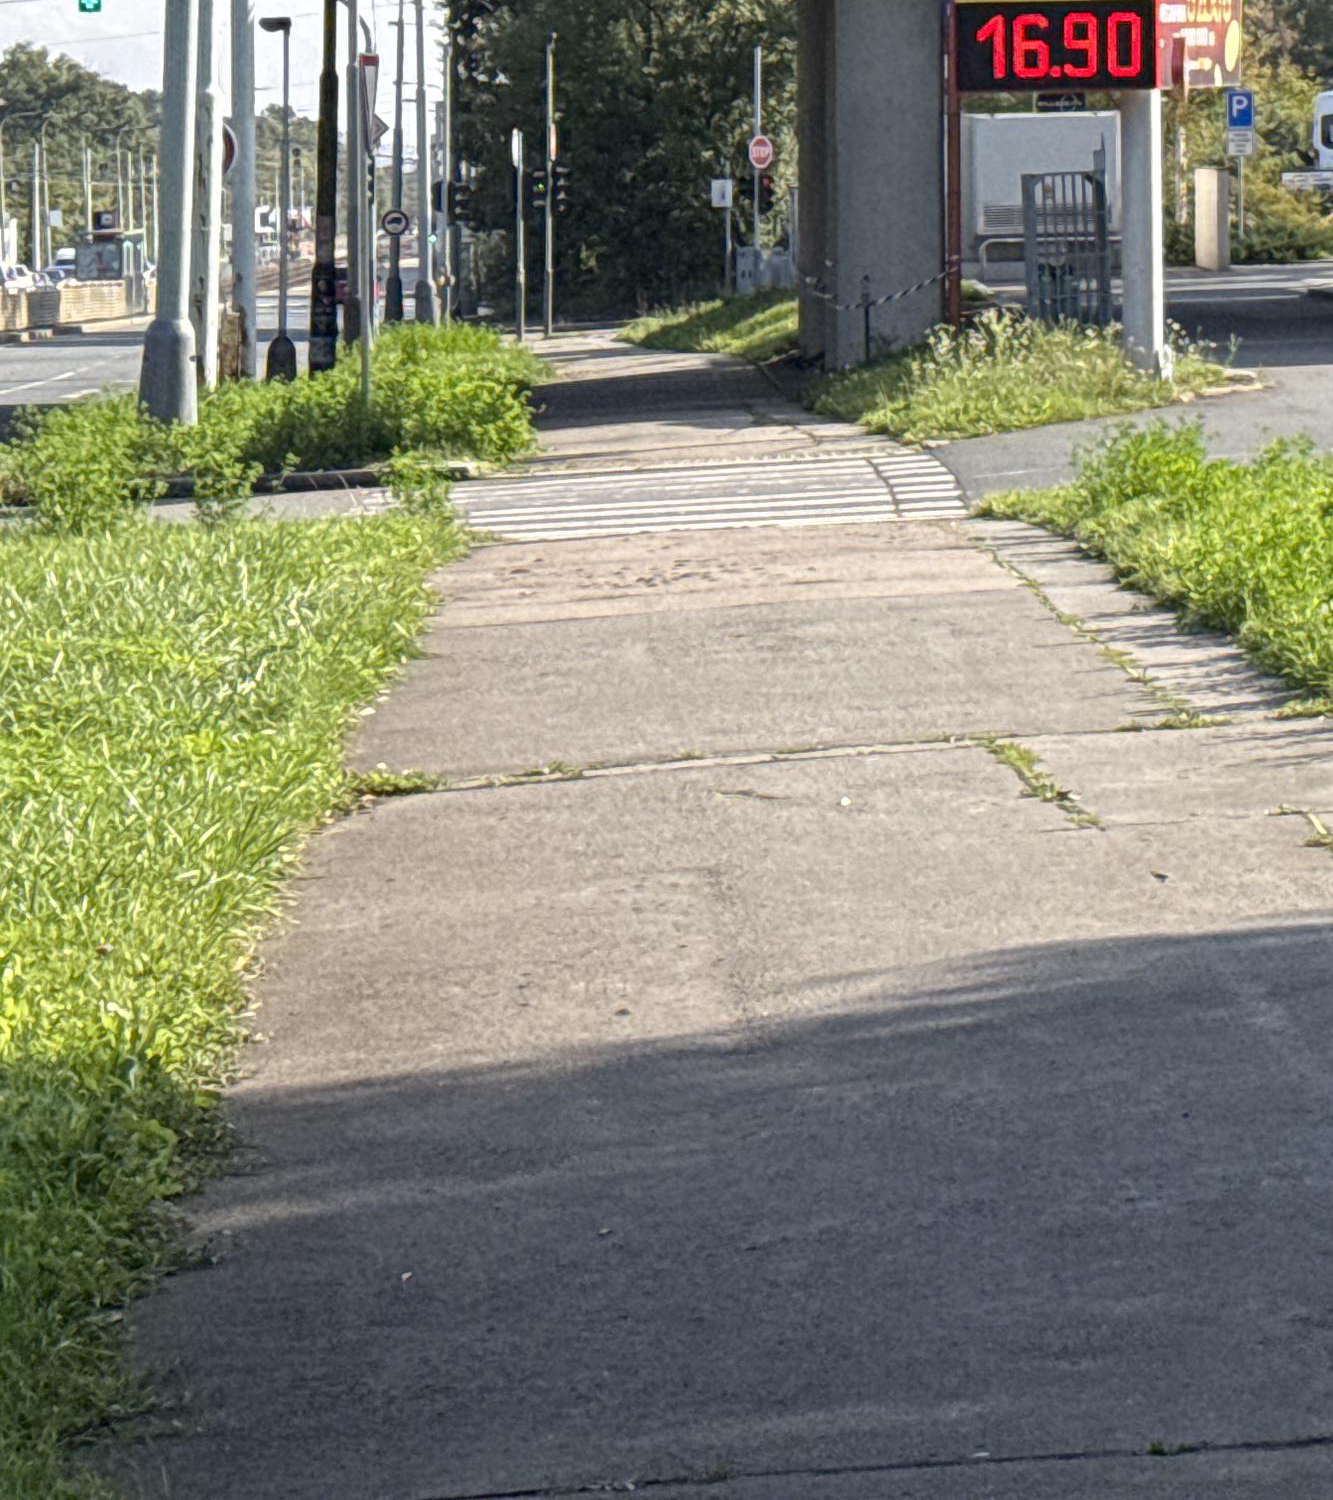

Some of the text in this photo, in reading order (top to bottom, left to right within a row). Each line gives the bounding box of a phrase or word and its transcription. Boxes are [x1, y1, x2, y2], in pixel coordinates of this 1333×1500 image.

[975, 11, 1142, 80] 16.90
[1231, 95, 1249, 118] P
[751, 146, 770, 157] STOP
